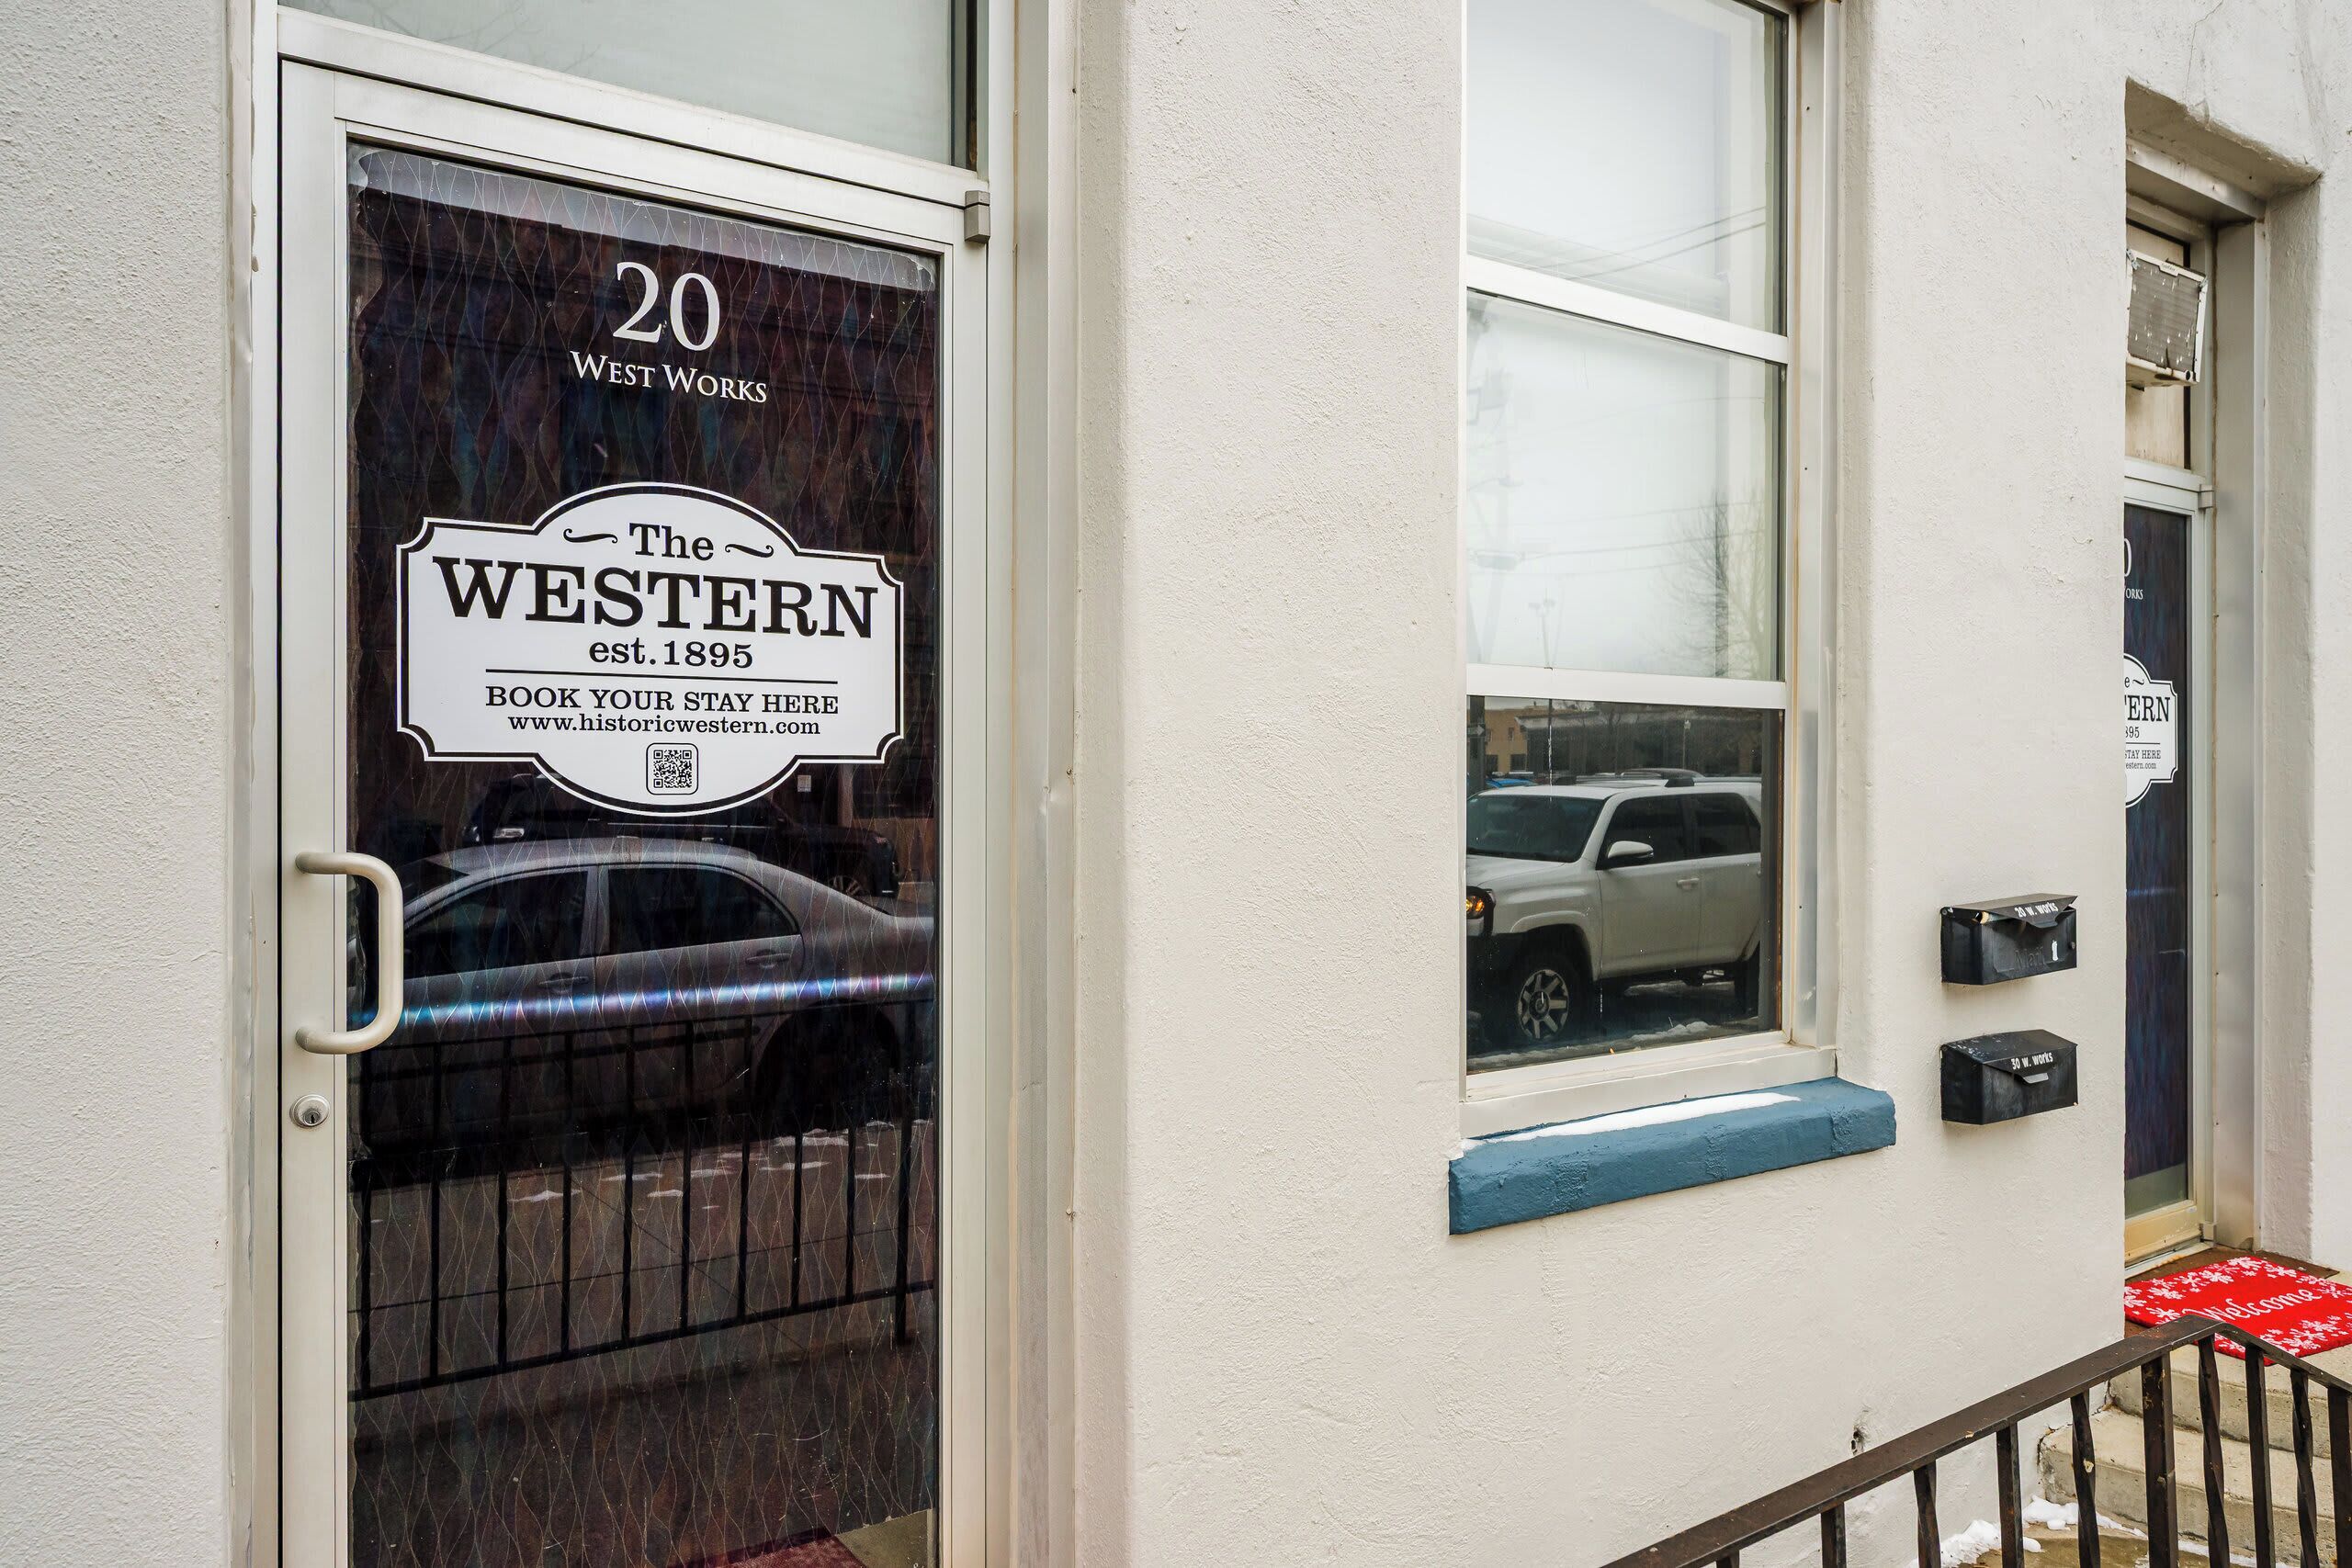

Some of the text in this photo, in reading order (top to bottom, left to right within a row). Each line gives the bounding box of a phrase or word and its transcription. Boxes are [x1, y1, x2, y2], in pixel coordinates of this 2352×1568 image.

[611, 261, 720, 351] 20
[628, 522, 714, 561] The
[432, 555, 878, 639] WESTERN
[485, 685, 839, 715] BOOK YOUR STAY HERE
[2124, 694, 2171, 722] ERN
[507, 713, 821, 736] www.historicwestern.com
[2142, 750, 2162, 760] HERE
[2014, 906, 2027, 918] 20
[2010, 1057, 2021, 1070] 30
[2181, 1288, 2323, 1322] Welcome
